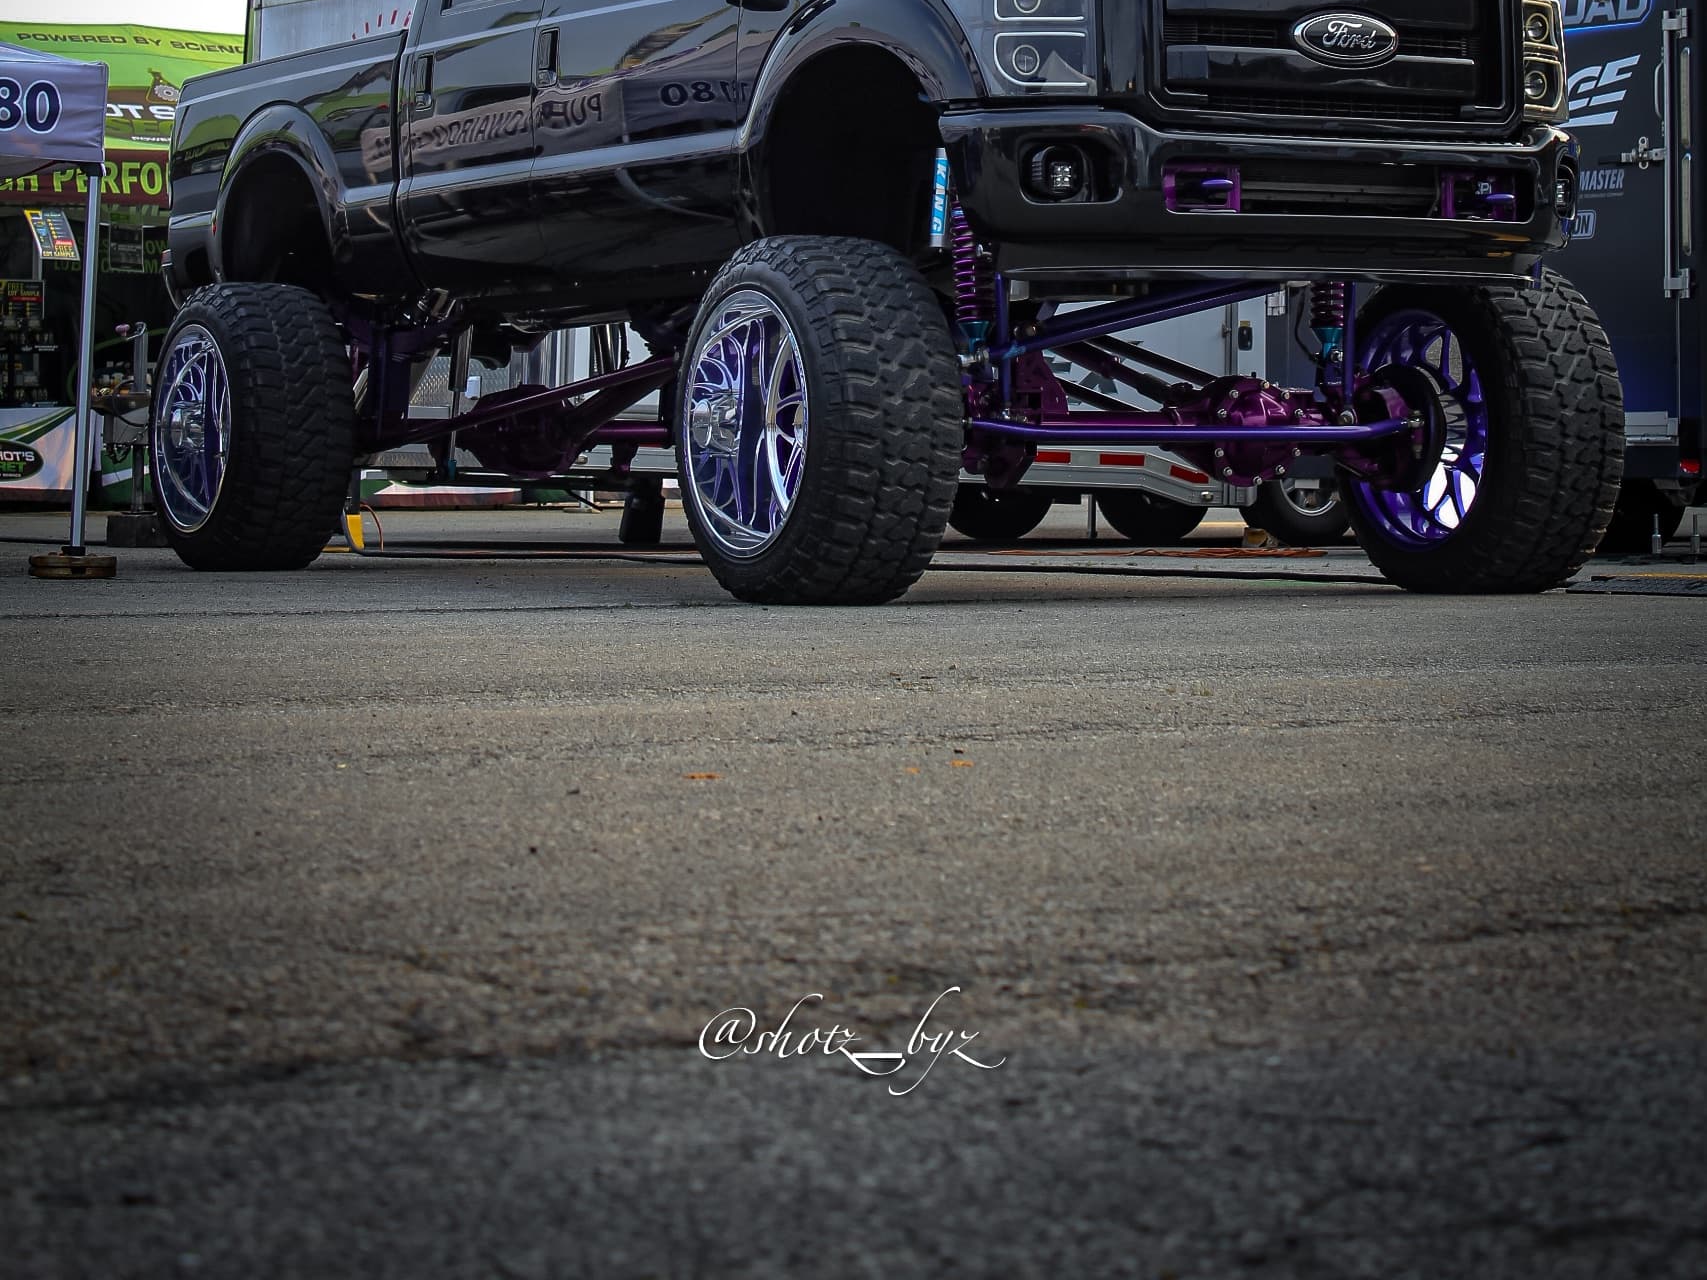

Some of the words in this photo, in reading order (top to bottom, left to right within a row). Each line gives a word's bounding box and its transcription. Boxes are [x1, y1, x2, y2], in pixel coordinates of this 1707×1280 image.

[17, 32, 128, 44] POWERED
[133, 35, 163, 47] BY
[1322, 20, 1377, 50] Ford
[932, 163, 947, 232] KING
